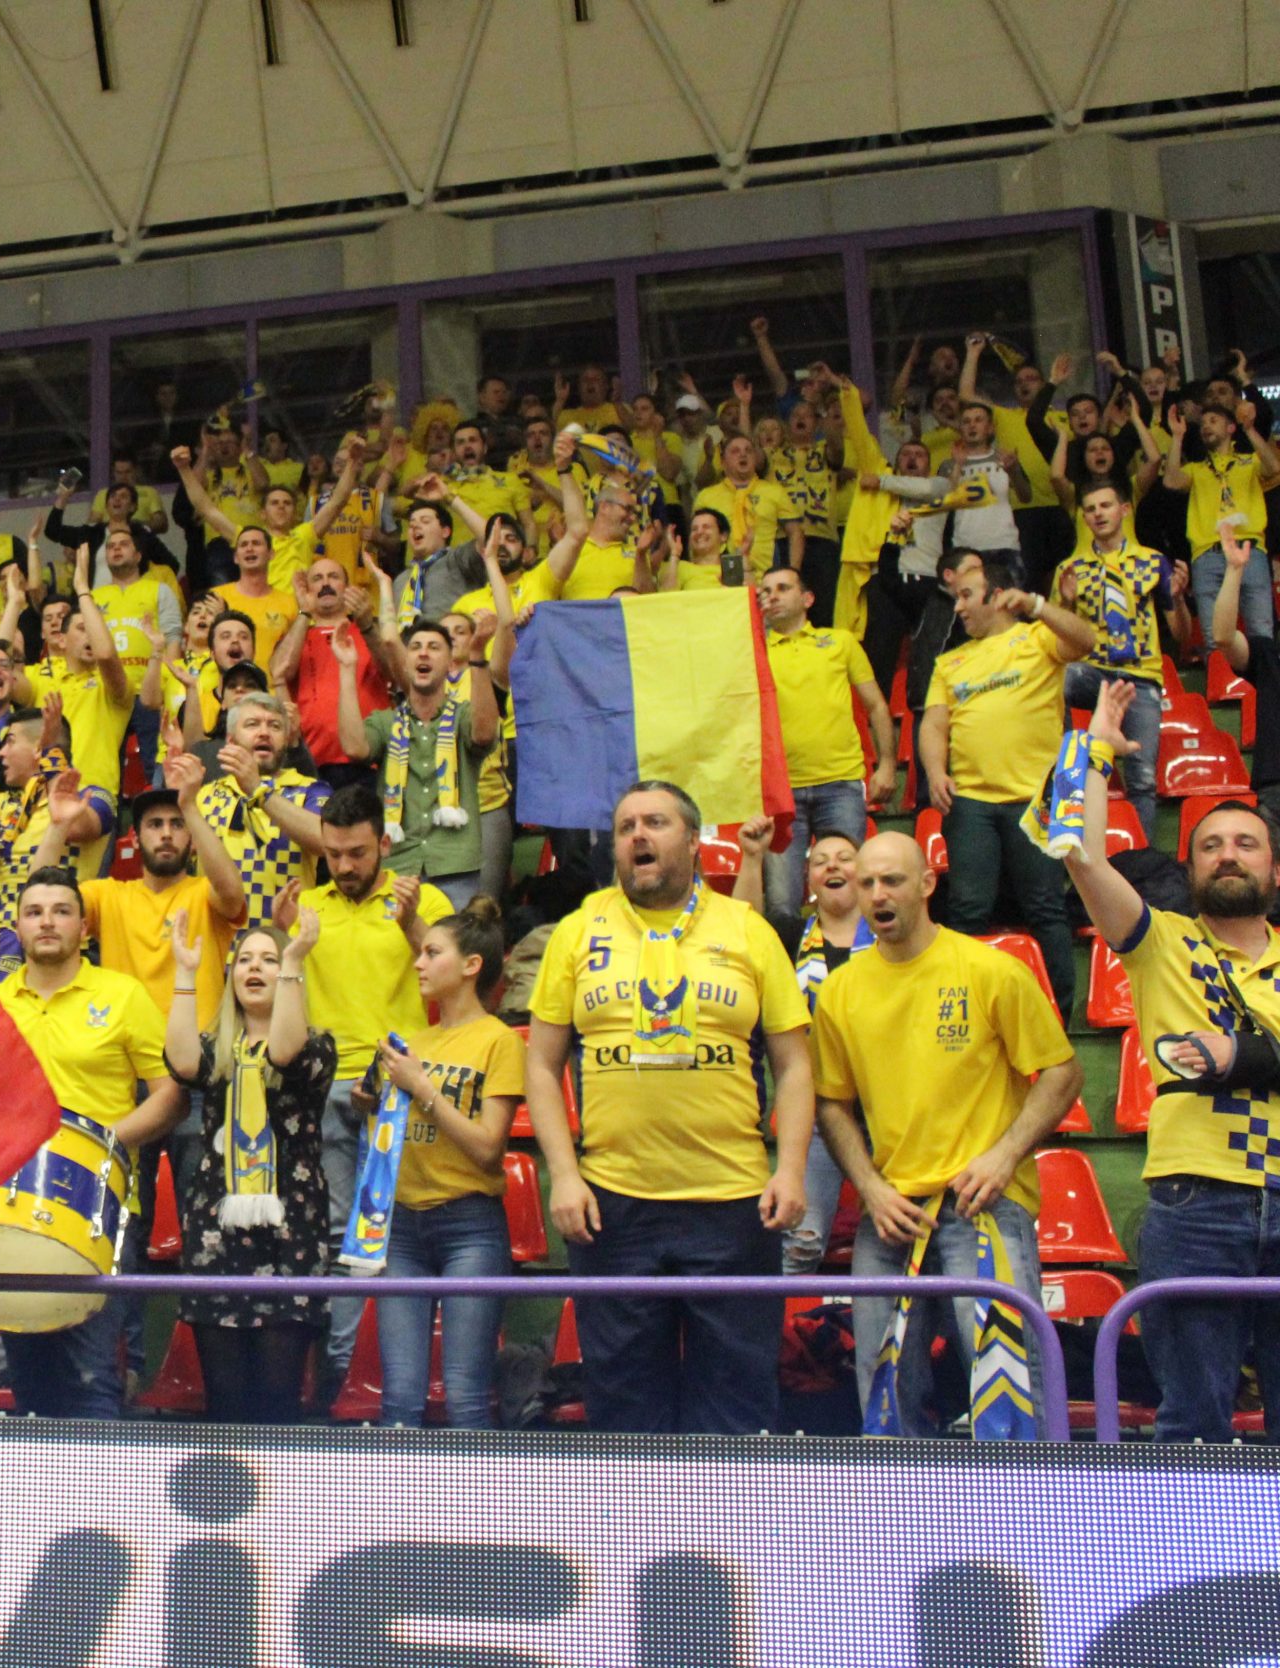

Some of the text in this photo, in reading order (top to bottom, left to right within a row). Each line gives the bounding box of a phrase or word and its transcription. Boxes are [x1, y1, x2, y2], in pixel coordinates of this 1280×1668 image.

[588, 935, 613, 972] 5
[583, 985, 609, 1012] BC
[938, 986, 968, 998] FAN
[938, 999, 968, 1021] #1
[936, 1024, 969, 1038] CSU
